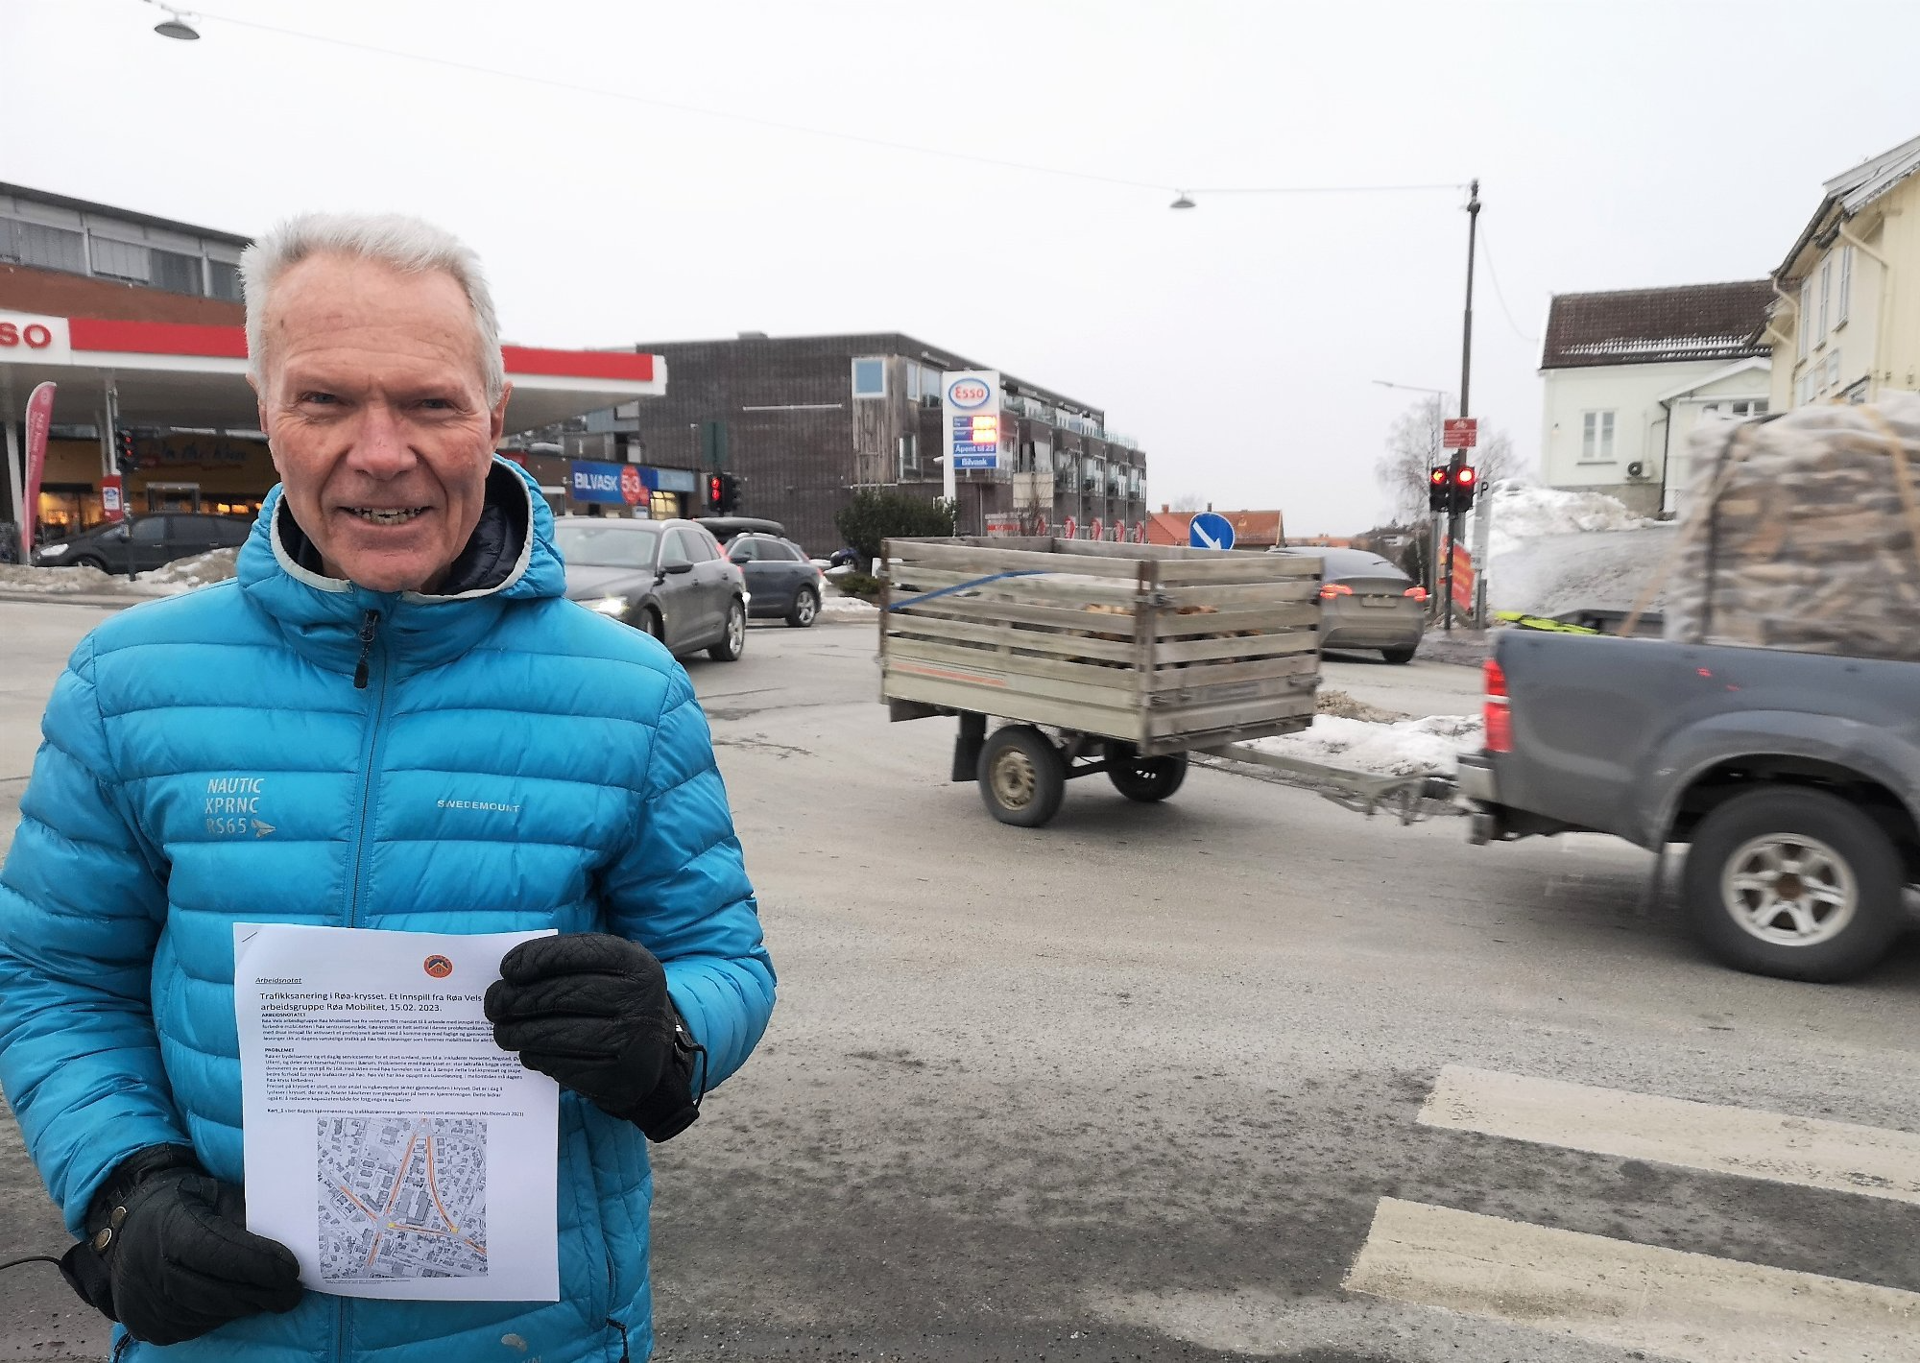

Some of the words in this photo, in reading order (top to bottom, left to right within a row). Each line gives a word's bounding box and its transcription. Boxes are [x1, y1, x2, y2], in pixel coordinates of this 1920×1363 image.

[955, 386, 984, 399] Esso
[574, 472, 618, 491] BILVASK
[1480, 481, 1489, 497] P
[206, 778, 265, 794] NAUTIC
[204, 797, 259, 815] XPRNC
[437, 799, 520, 814] SWEDEMOUNT
[205, 817, 248, 835] RS65
[260, 992, 328, 1001] Trafikksanering
[334, 992, 387, 1002] Røa-krysset.
[261, 1003, 325, 1012] arbeidsgruppe
[345, 1003, 388, 1012] Mobilitet,
[390, 1003, 416, 1011] 15.02.
[418, 1004, 443, 1012] 2023.
